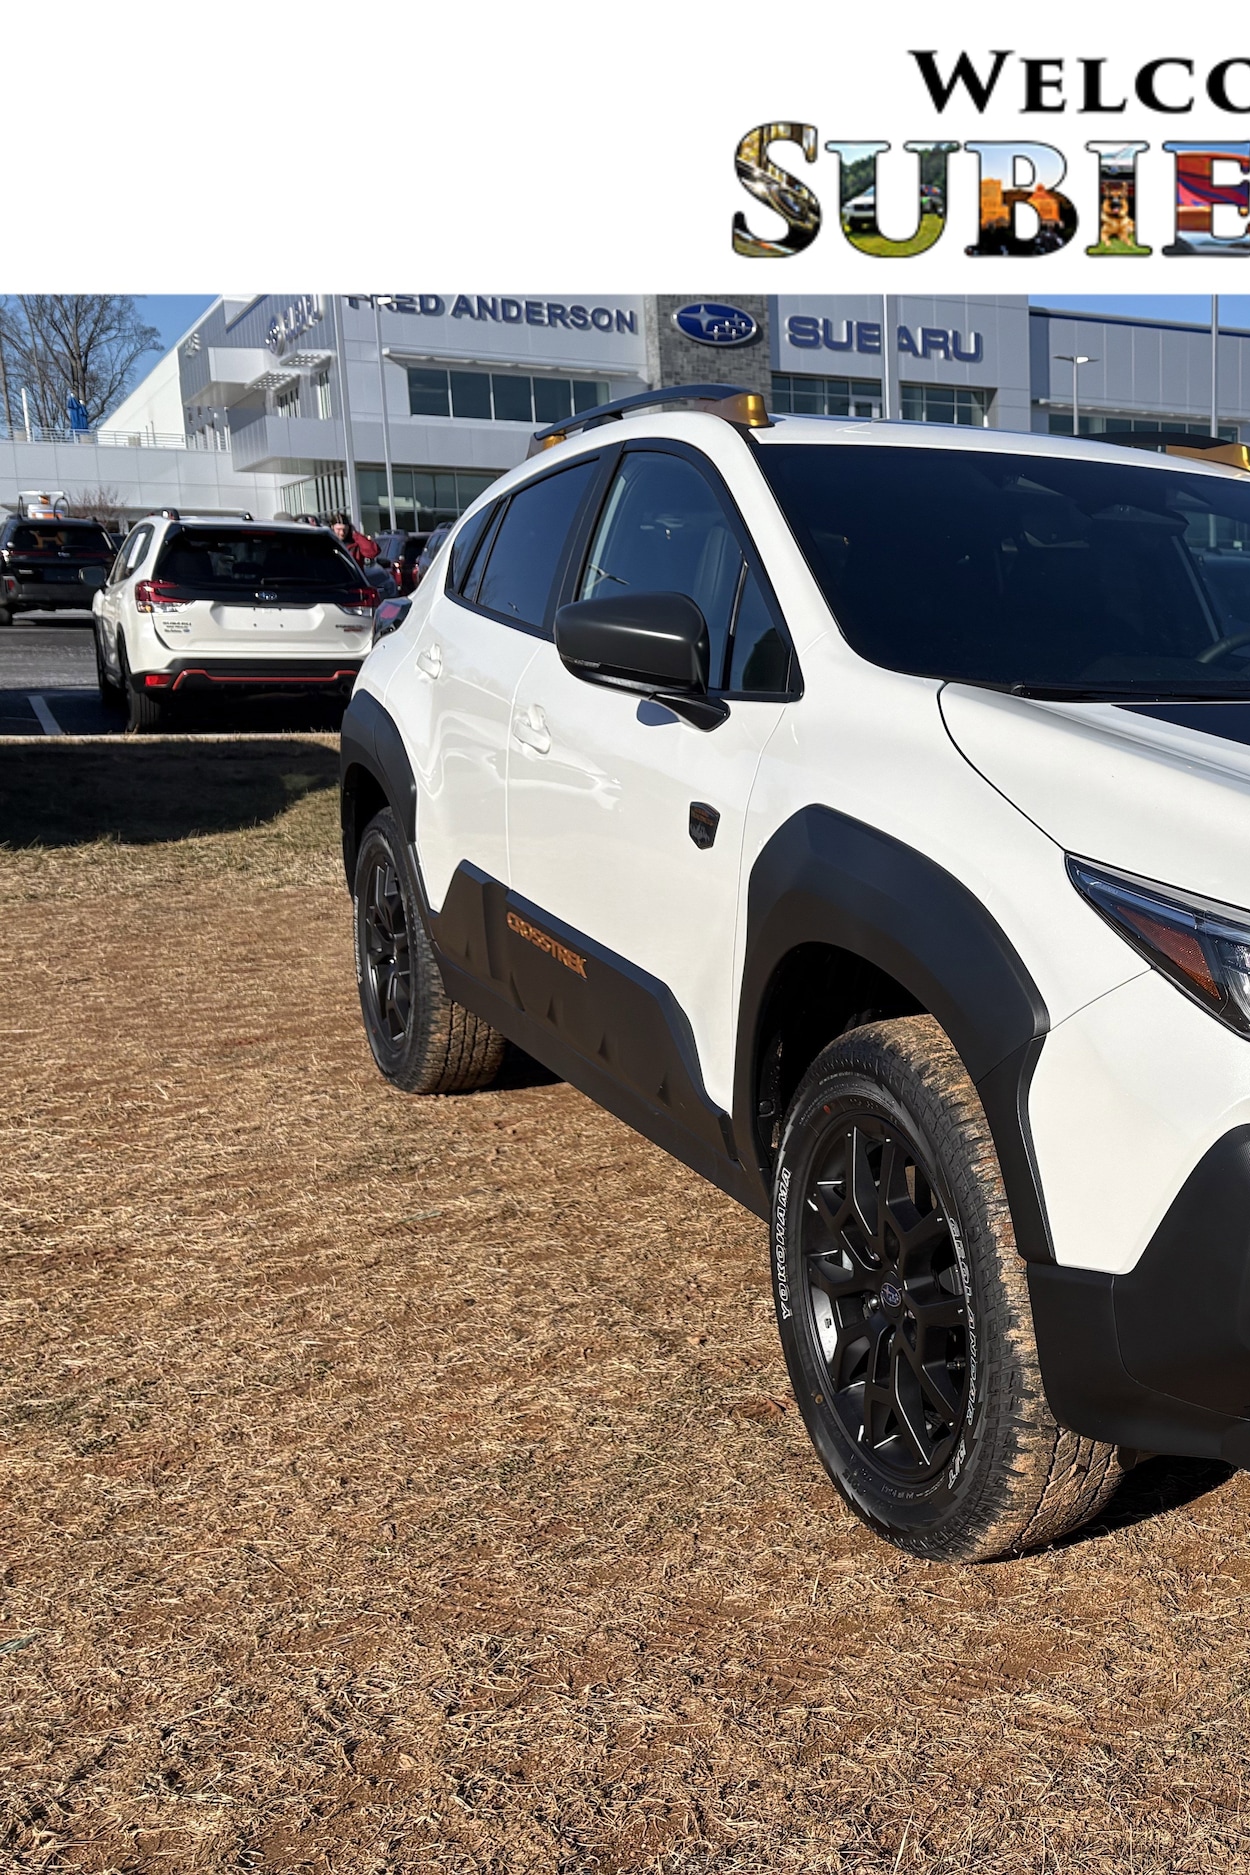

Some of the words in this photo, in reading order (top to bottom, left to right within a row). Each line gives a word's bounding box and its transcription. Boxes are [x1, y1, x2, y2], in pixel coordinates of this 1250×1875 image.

[450, 294, 638, 334] ANDERSON
[786, 315, 983, 362] SUBARU
[507, 911, 588, 980] CROSSTREK
[776, 1167, 792, 1320] YOKOHAMA
